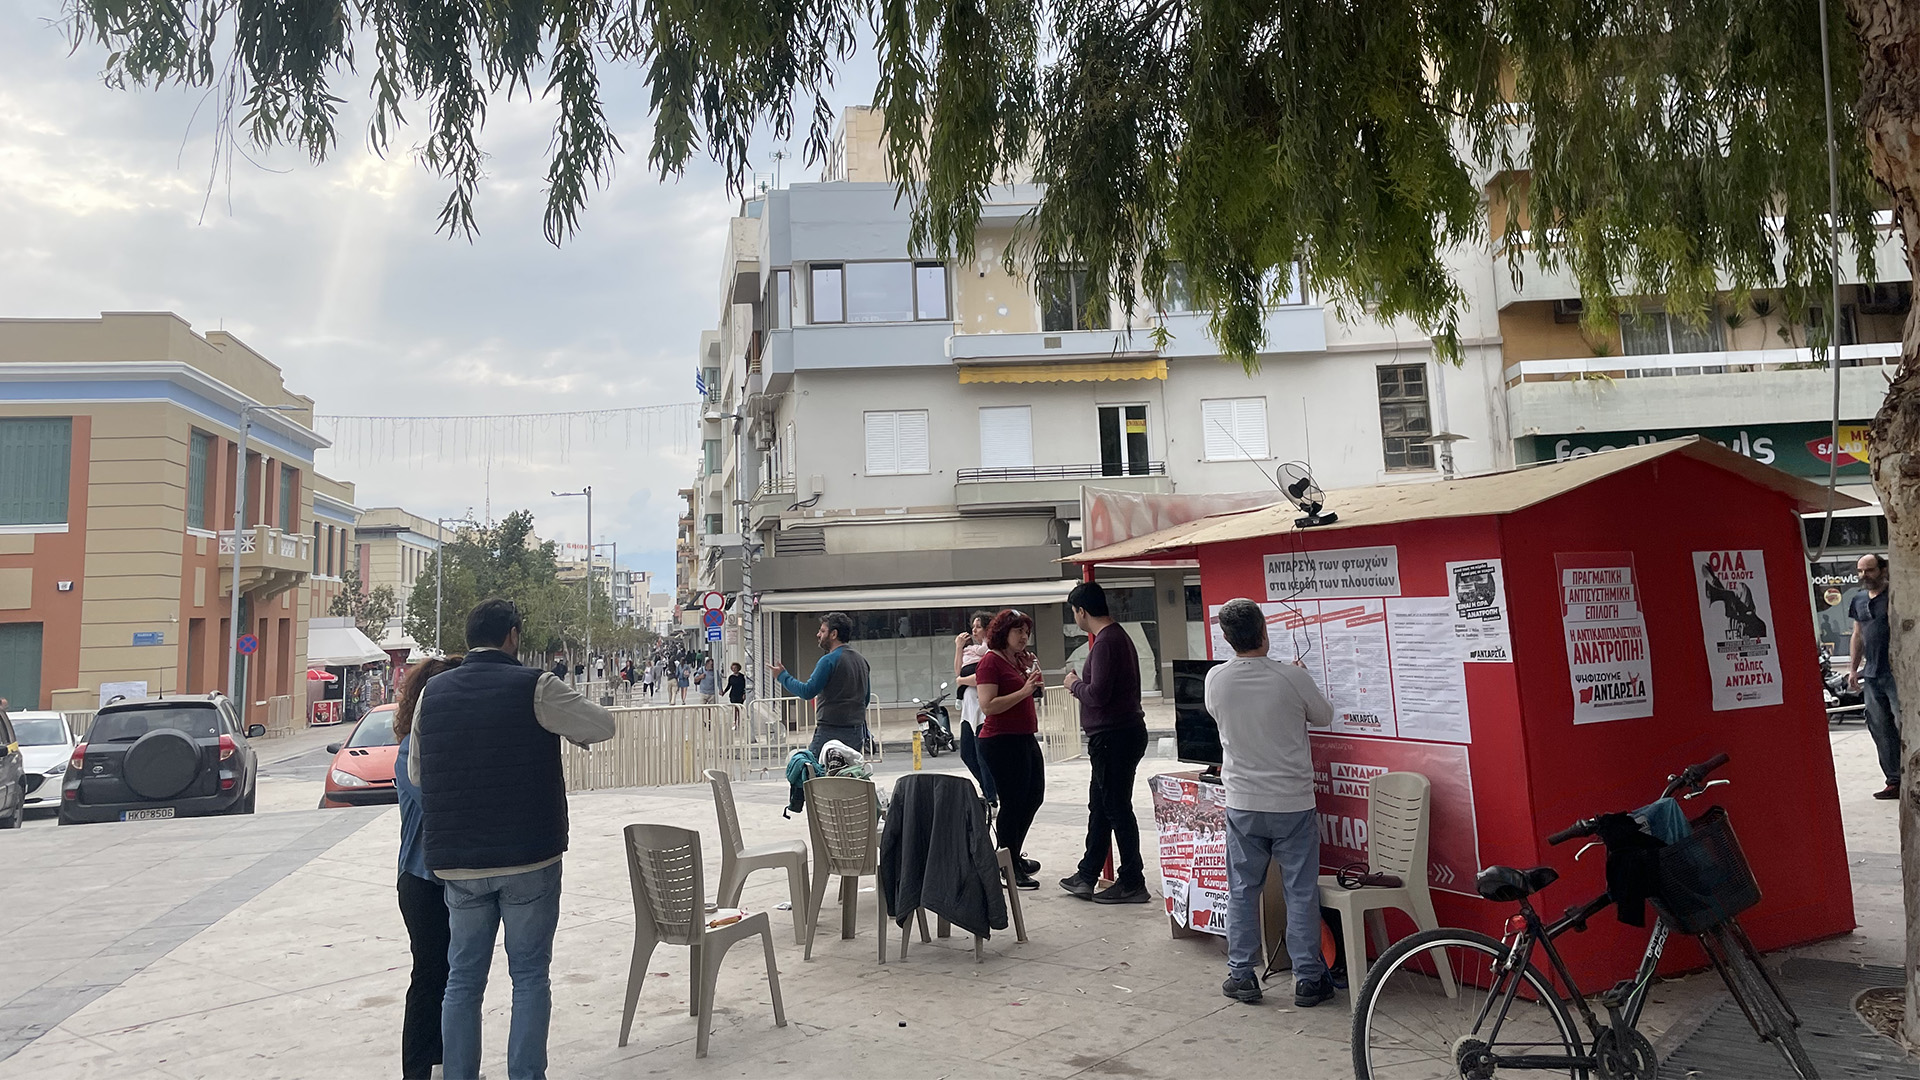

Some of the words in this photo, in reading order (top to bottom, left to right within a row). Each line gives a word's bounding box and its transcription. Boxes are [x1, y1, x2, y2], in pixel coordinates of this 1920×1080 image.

[1268, 559, 1316, 574] ΑΝΤΑΡΣΥΑ
[1319, 560, 1339, 570] των
[1342, 555, 1388, 573] φτωχών
[1709, 551, 1746, 572] ΟΛΑ
[1269, 581, 1287, 591] στα
[1288, 577, 1318, 592] κέρδη
[1319, 579, 1339, 588] των
[1341, 574, 1395, 588] πλουσίων
[1572, 569, 1622, 585] ΠΡΑΓΜΑΤΙΚΗ
[1731, 571, 1754, 579] ΟΛΟΥΣ
[1569, 587, 1630, 603] ΑΝΤΙΣΥΣΤΗΜΙΚΗ
[1585, 604, 1619, 620] ΕΠΙΛΟΓΗ
[1570, 629, 1575, 642] Η
[1576, 626, 1642, 641] ΑΝΤΙΚΑΠΙΤΑΛΙΣΤΙΚΗ
[1573, 639, 1644, 665] ΑΝΑΤΡΟΠΗ!
[1734, 657, 1764, 672] κάλπες
[1575, 671, 1621, 683] ΨΗΦΙΖΟΥΜΕ
[1725, 672, 1774, 688] ΑΝΤΑΡΣΥΑ
[1338, 782, 1369, 796] ΑΝΑΤ
[1194, 856, 1226, 866] ΑΡΙΣΤΕΡΑ
[1213, 901, 1227, 911] ψηφ
[1210, 911, 1227, 928] ΑΝ
